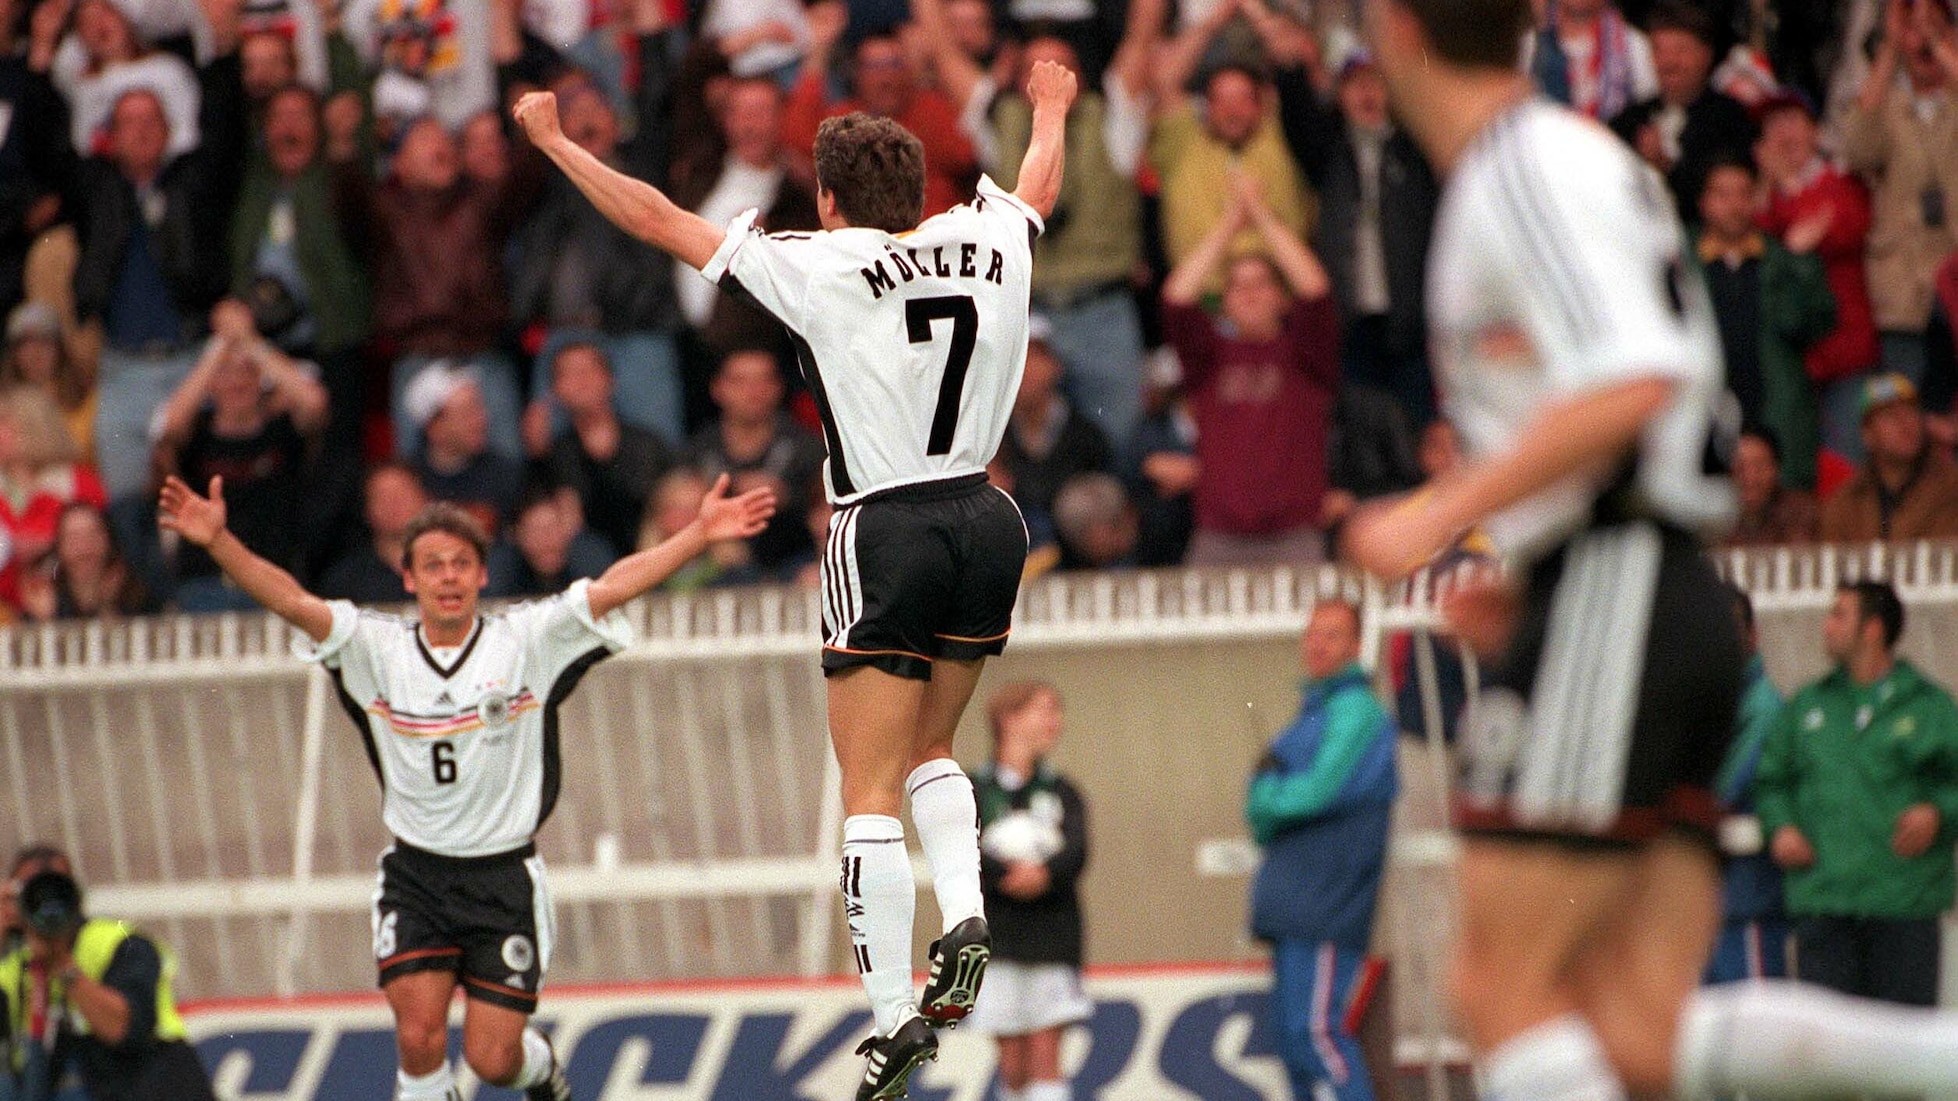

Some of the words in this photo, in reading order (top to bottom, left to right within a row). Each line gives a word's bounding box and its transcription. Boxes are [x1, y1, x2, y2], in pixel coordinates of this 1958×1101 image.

[861, 243, 1003, 299] MÖLLER
[905, 294, 978, 456] 7
[432, 740, 457, 784] 6
